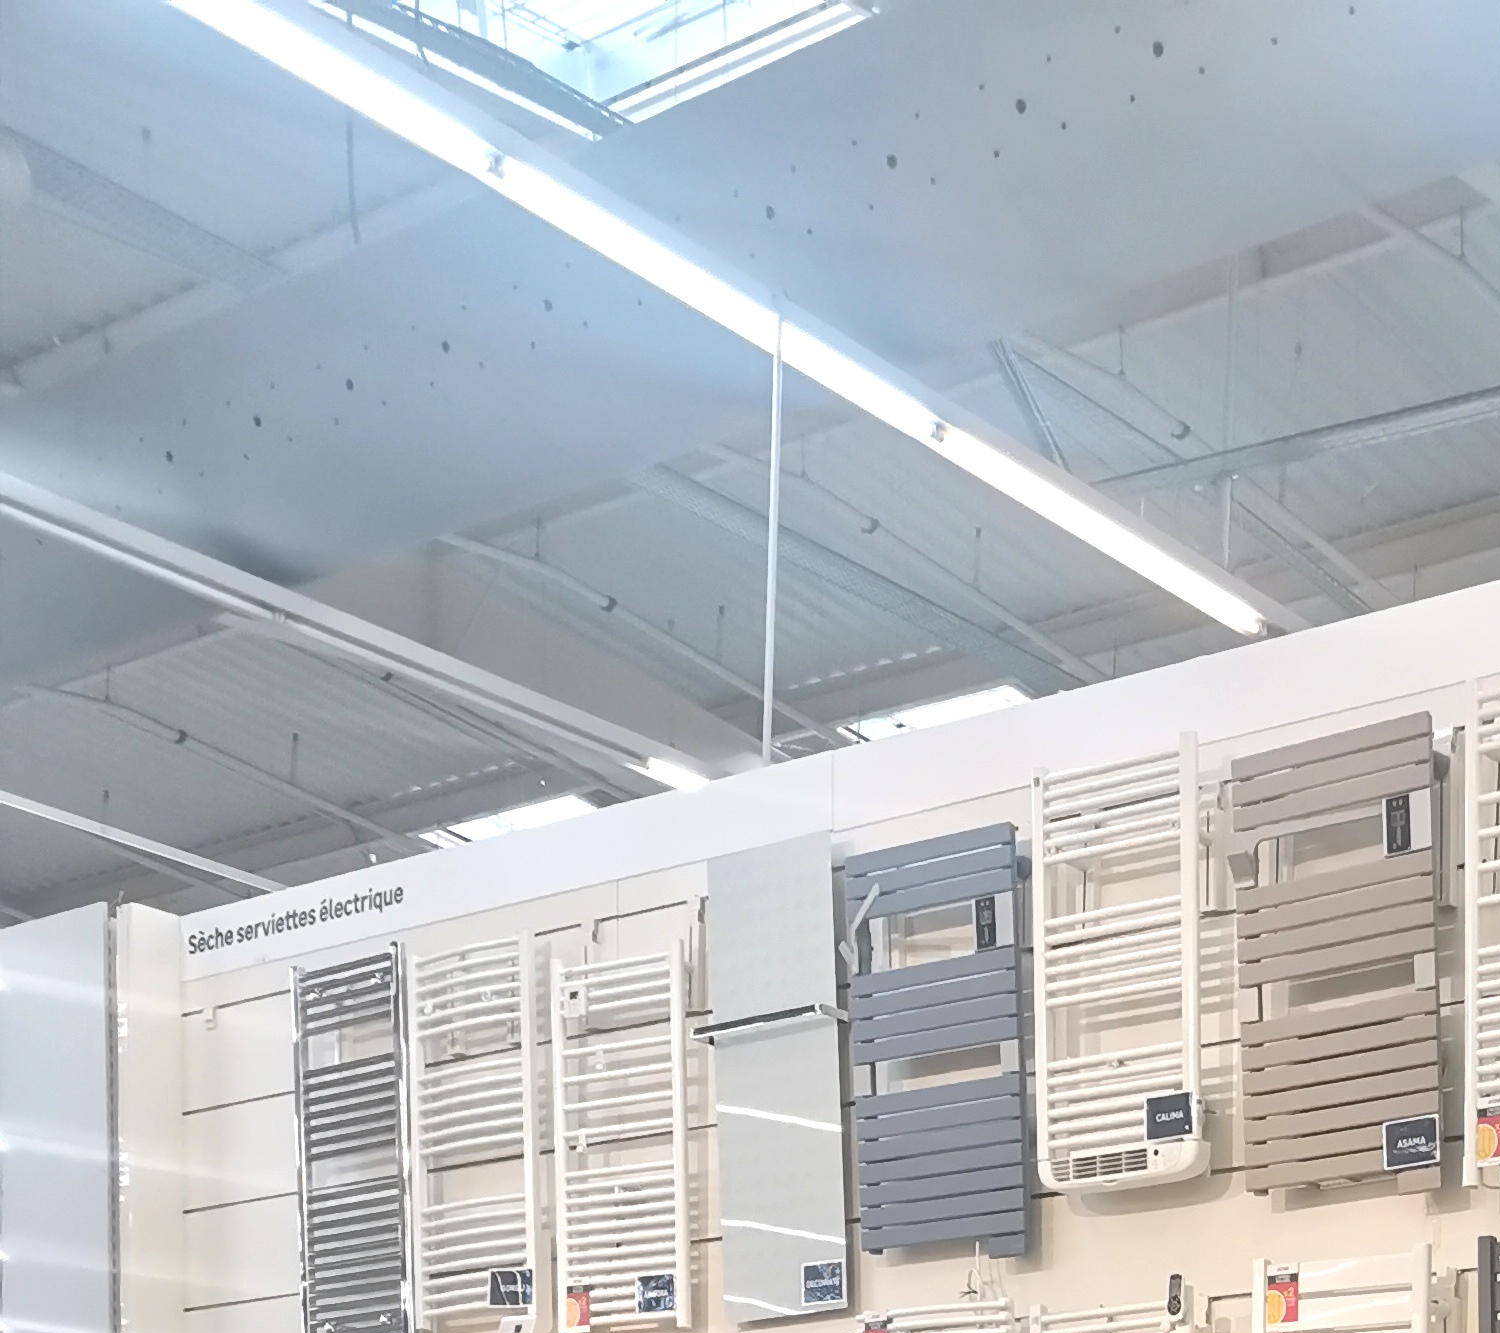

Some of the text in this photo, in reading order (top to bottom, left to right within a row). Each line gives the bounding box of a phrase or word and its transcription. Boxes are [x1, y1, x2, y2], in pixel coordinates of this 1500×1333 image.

[188, 886, 404, 955] Sèche serviettes électrique
